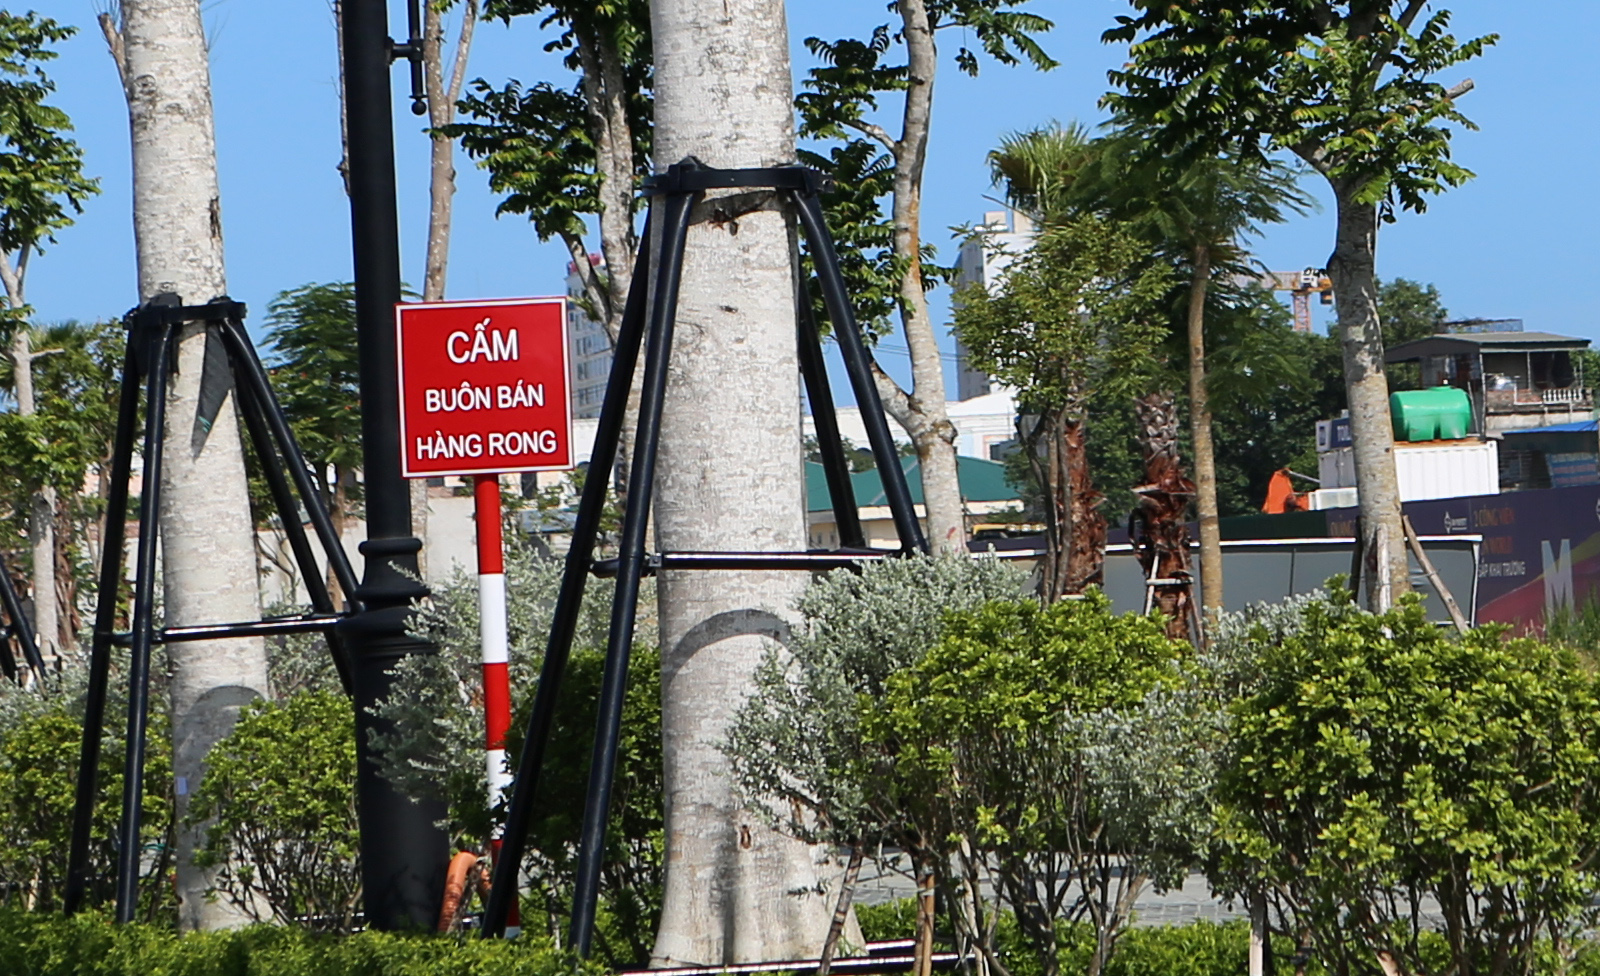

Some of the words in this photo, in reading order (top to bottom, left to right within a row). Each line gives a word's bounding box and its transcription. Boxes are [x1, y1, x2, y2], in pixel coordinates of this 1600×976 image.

[447, 317, 519, 364] CẤM
[425, 381, 491, 412] BUÔN
[497, 379, 544, 409] BÁN
[416, 430, 483, 460] HÀNG
[488, 429, 557, 456] RONG
